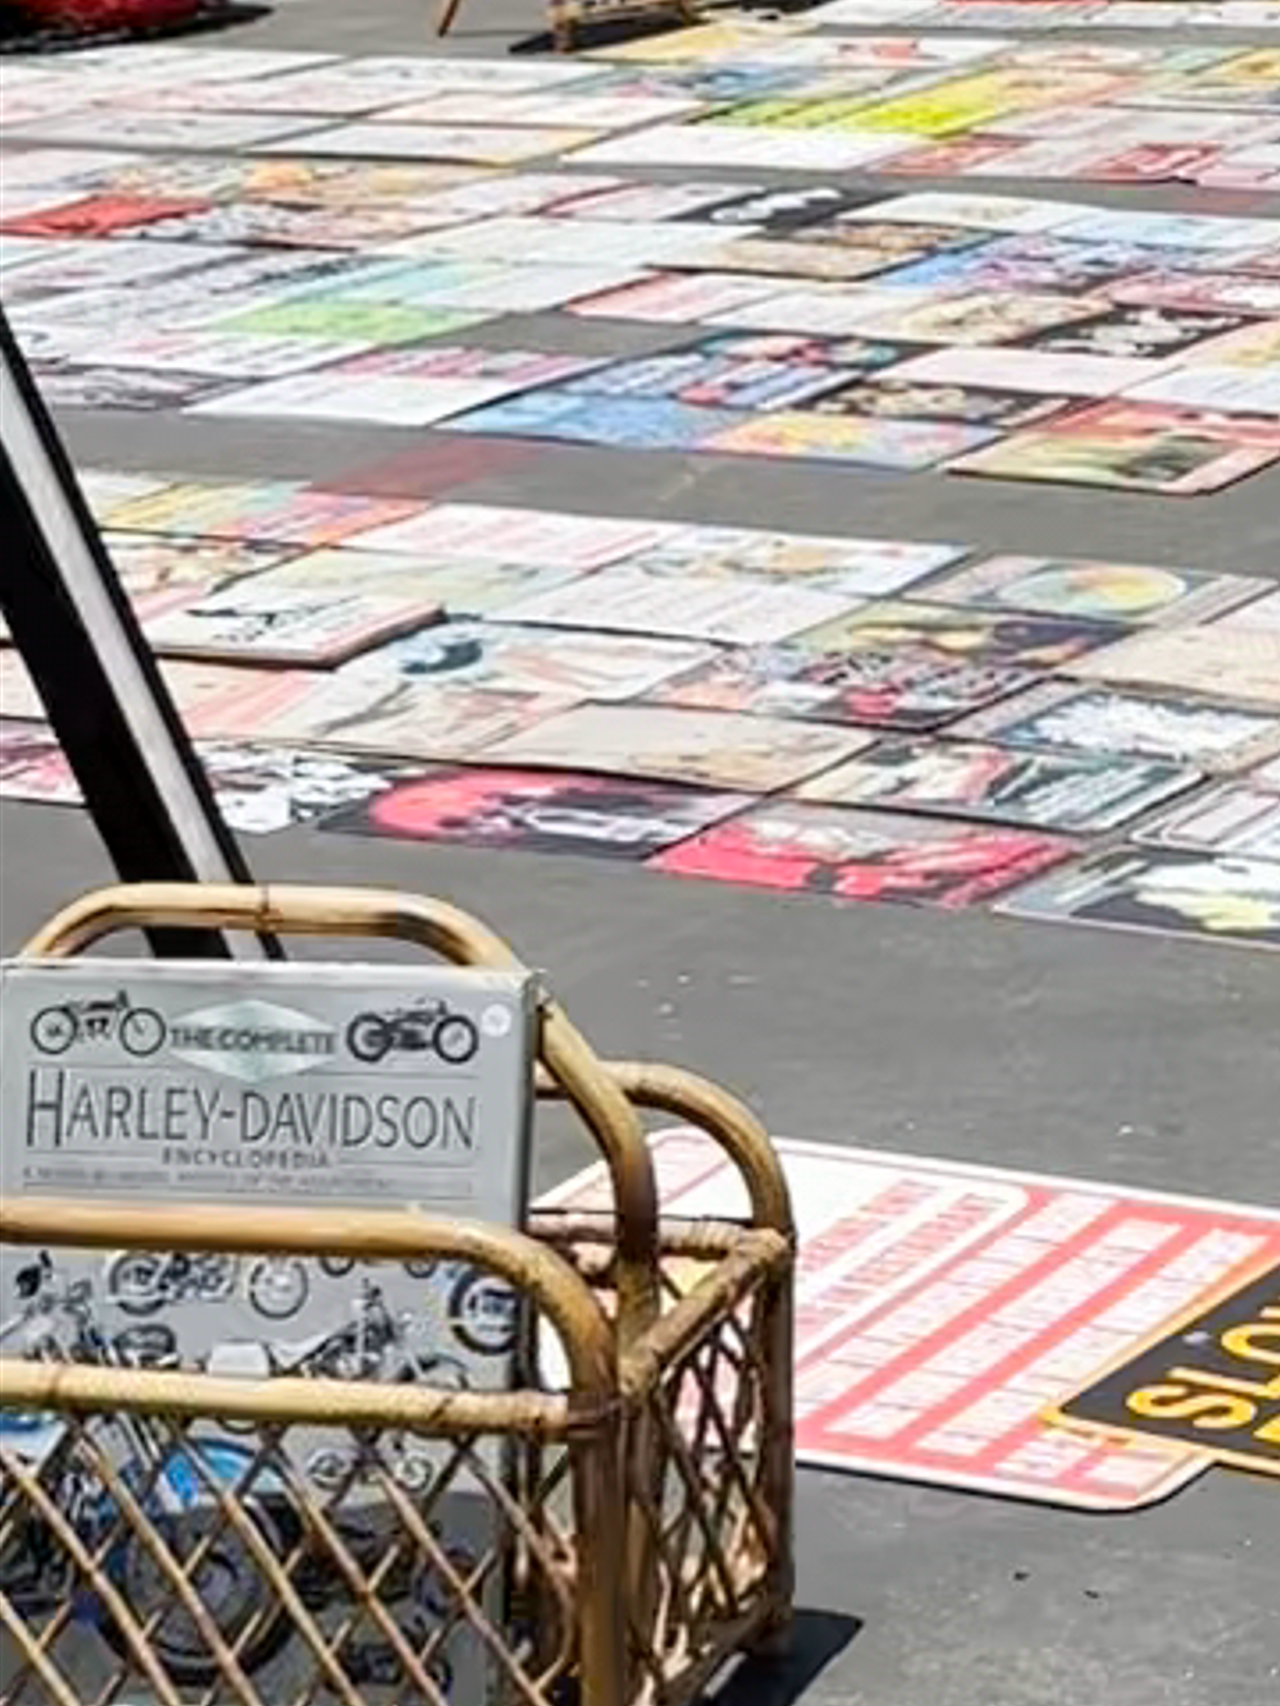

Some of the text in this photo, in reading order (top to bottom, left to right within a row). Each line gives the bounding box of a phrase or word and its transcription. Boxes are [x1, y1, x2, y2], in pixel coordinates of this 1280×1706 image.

[172, 1026, 337, 1055] THE COMPLETE
[26, 1069, 477, 1149] HARLEY-DAVIDSON
[162, 1146, 330, 1170] ENCYCLOPEDIA
